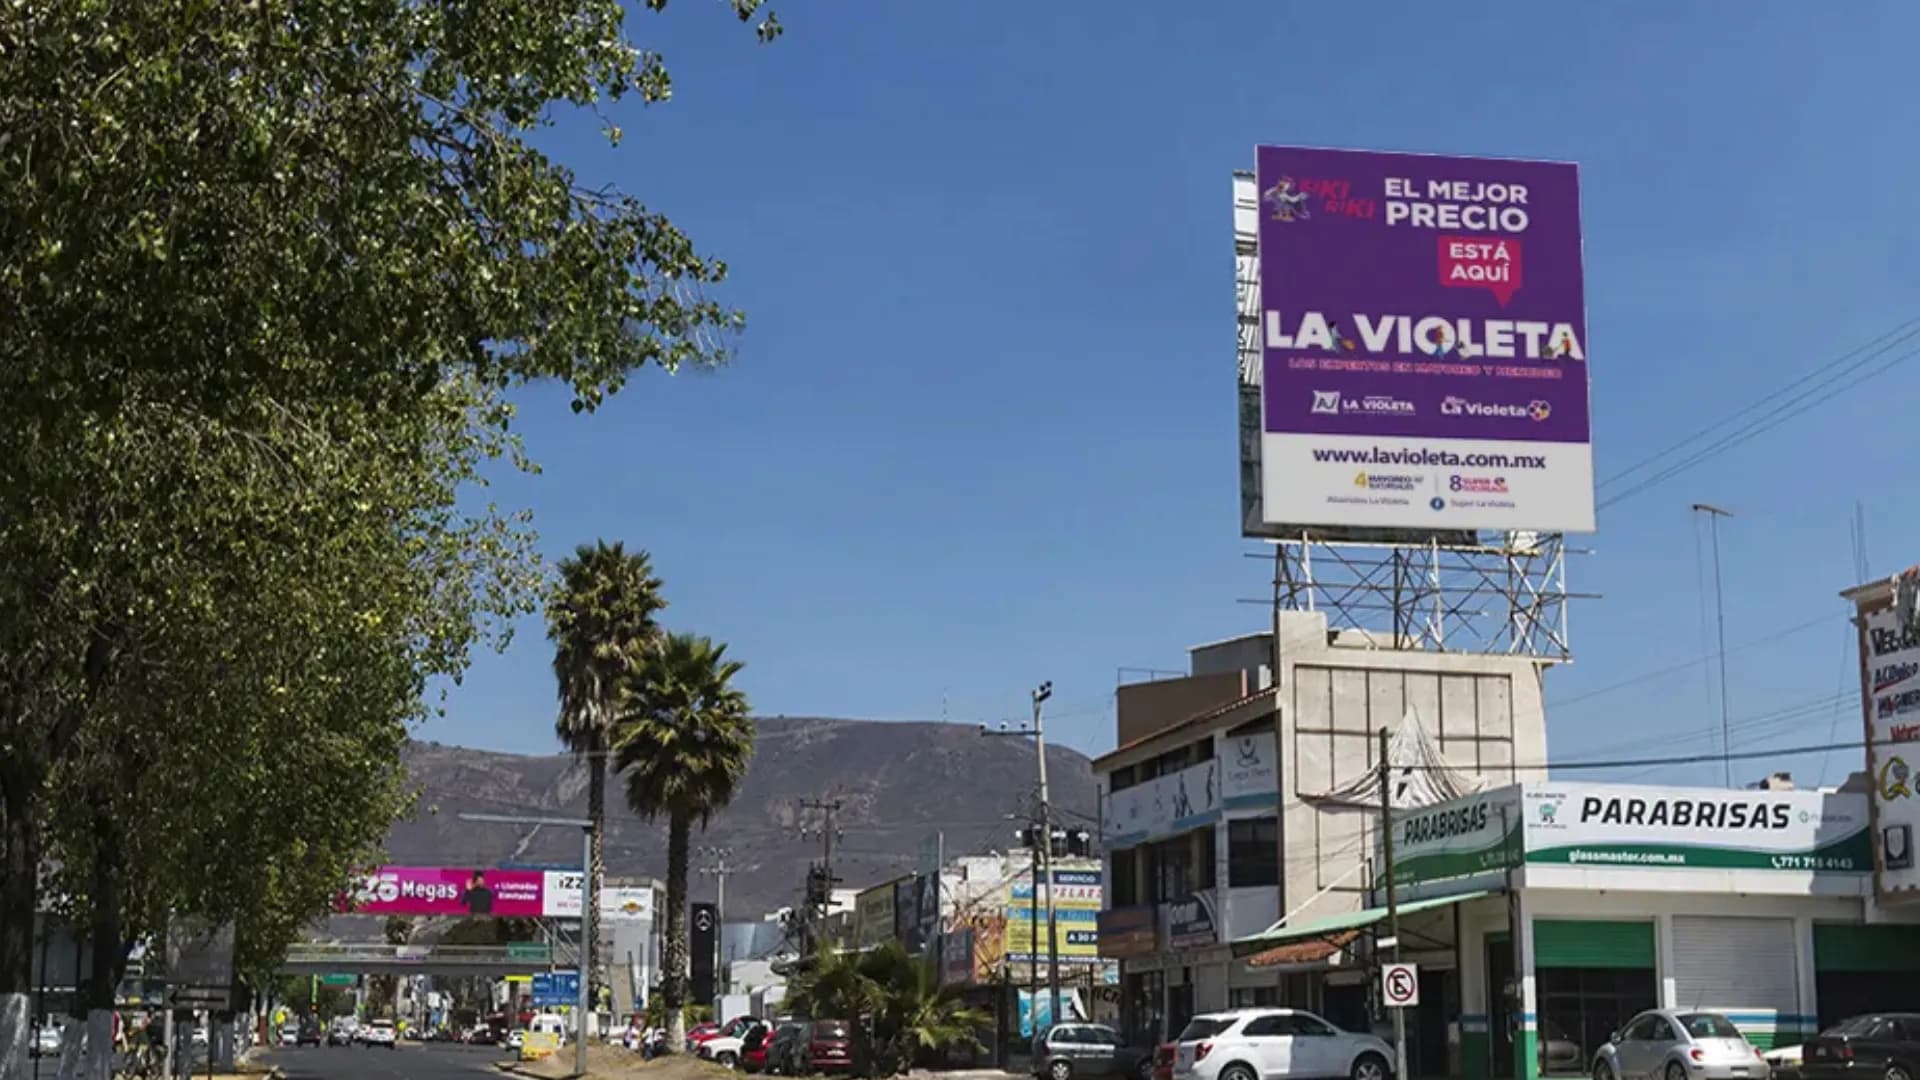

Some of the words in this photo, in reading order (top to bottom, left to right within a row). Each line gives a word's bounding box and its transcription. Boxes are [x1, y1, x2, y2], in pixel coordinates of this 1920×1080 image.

[1385, 177, 1420, 198] EL
[1428, 180, 1528, 204] MEJOR
[1385, 201, 1529, 233] PRECIO
[1450, 241, 1511, 261] ESTÁ
[1450, 262, 1510, 283] AQUÍ
[1265, 310, 1334, 350] LA
[1352, 313, 1585, 361] VIOLETA
[1343, 400, 1359, 410] LA
[1363, 401, 1415, 411] VIOLETA
[1441, 402, 1462, 415] La
[1466, 402, 1527, 417] Violeta
[1312, 446, 1546, 469] www.lavioleta.com.mx
[1354, 471, 1367, 488] 4
[1449, 475, 1461, 492] 8
[1404, 801, 1488, 846] PARABRISAS
[1581, 797, 1791, 829] PARABRISAS
[1569, 850, 1685, 864] glassmaster.com.mx
[402, 880, 458, 903] Megas
